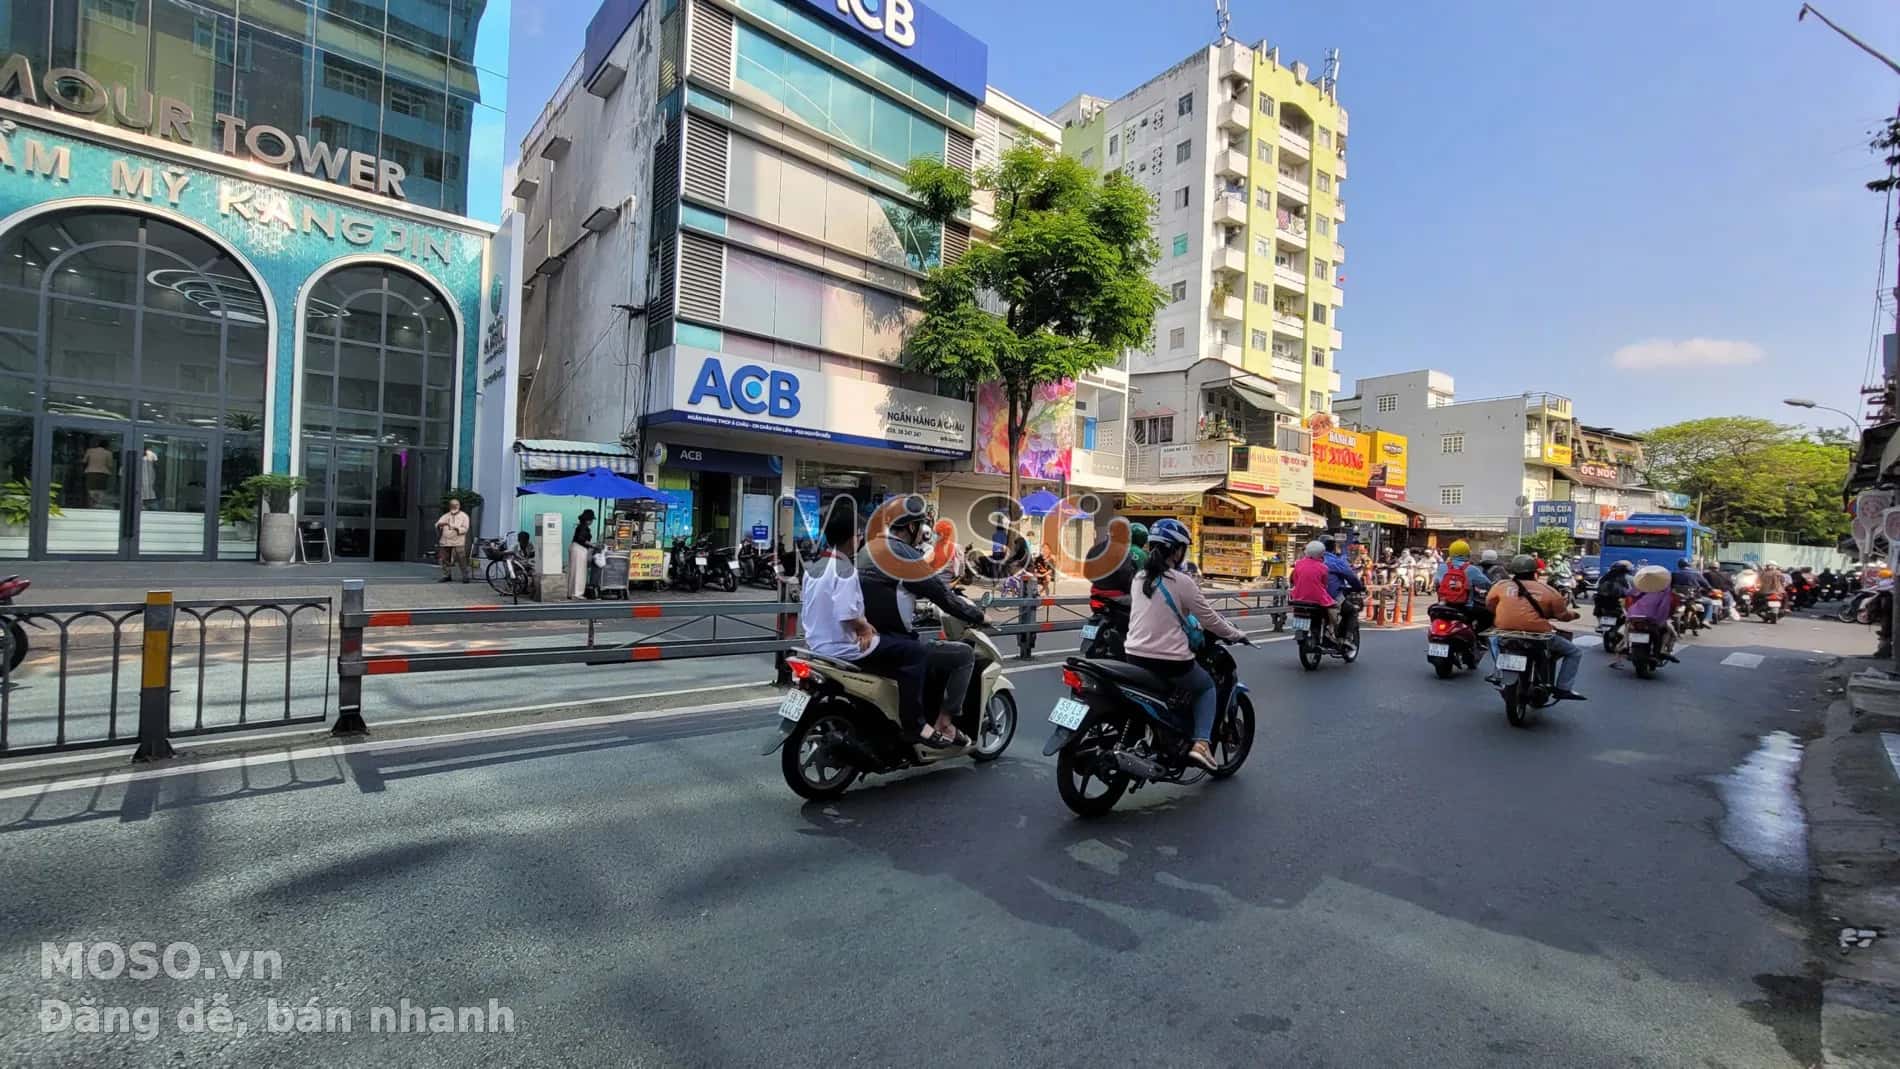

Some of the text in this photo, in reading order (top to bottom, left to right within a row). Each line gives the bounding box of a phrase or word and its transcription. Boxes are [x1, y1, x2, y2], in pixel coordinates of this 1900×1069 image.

[837, 0, 915, 47] CB
[215, 112, 406, 200] TOWER
[217, 182, 376, 245] KANG
[384, 224, 451, 265] JIN
[687, 357, 802, 419] ACB
[680, 450, 703, 461] ACB
